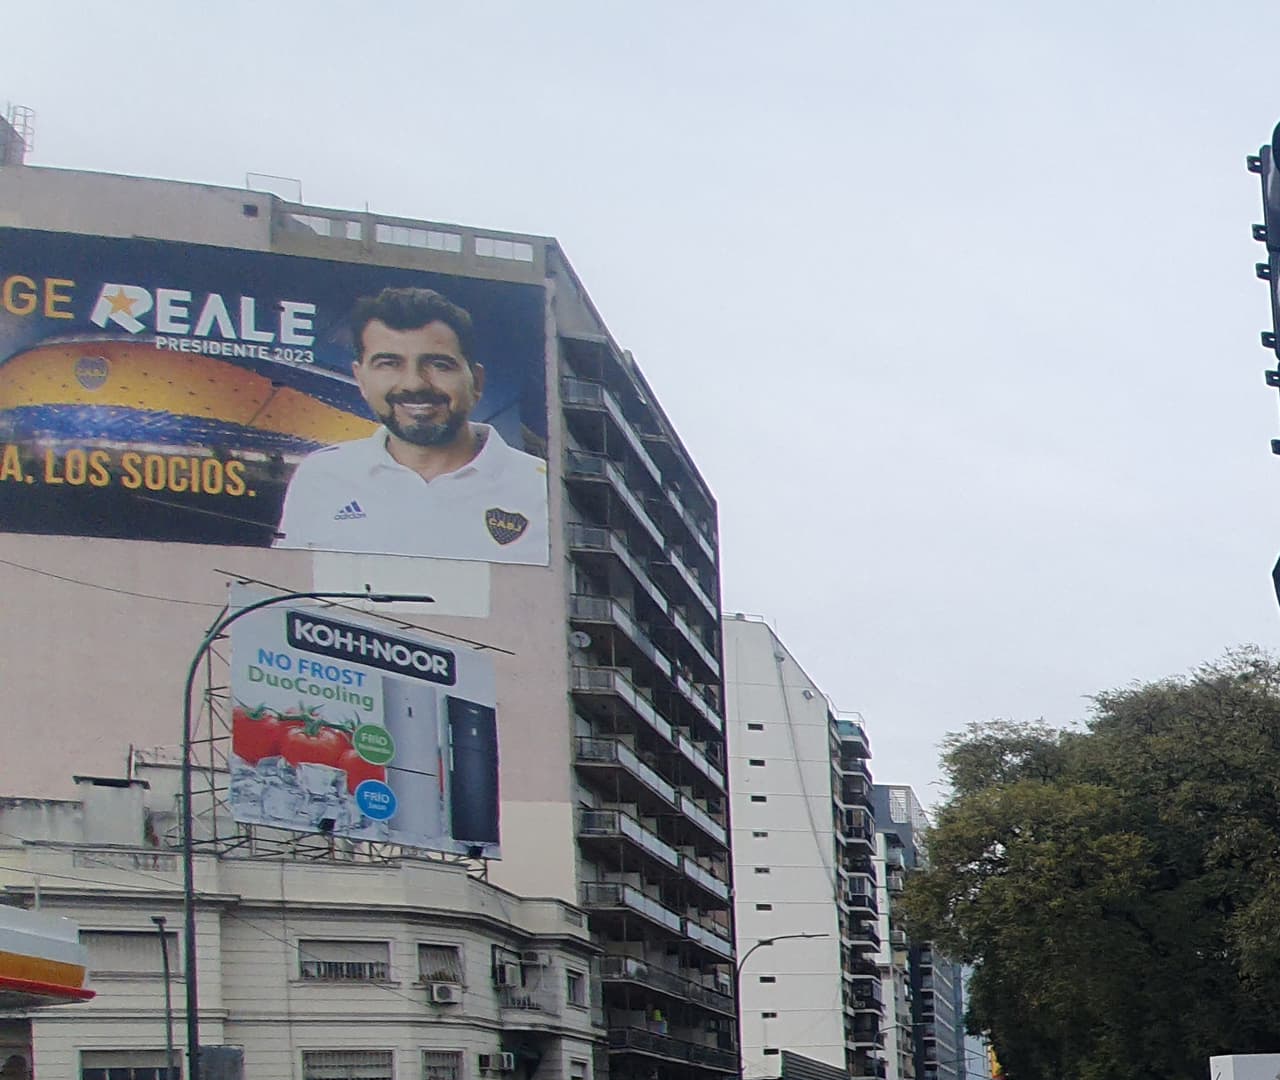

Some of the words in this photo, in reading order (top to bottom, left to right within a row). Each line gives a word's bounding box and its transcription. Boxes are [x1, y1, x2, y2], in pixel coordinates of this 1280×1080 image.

[90, 282, 317, 347] REALE
[156, 335, 269, 360] PRESIDENTE
[274, 346, 315, 364] 2023
[44, 448, 112, 487] LOS
[120, 451, 256, 497] SOCIOS.
[257, 648, 292, 671] NO
[298, 657, 367, 687] FROST
[295, 618, 449, 677] KOH-I-NOOR
[248, 665, 374, 712] DuoCooling
